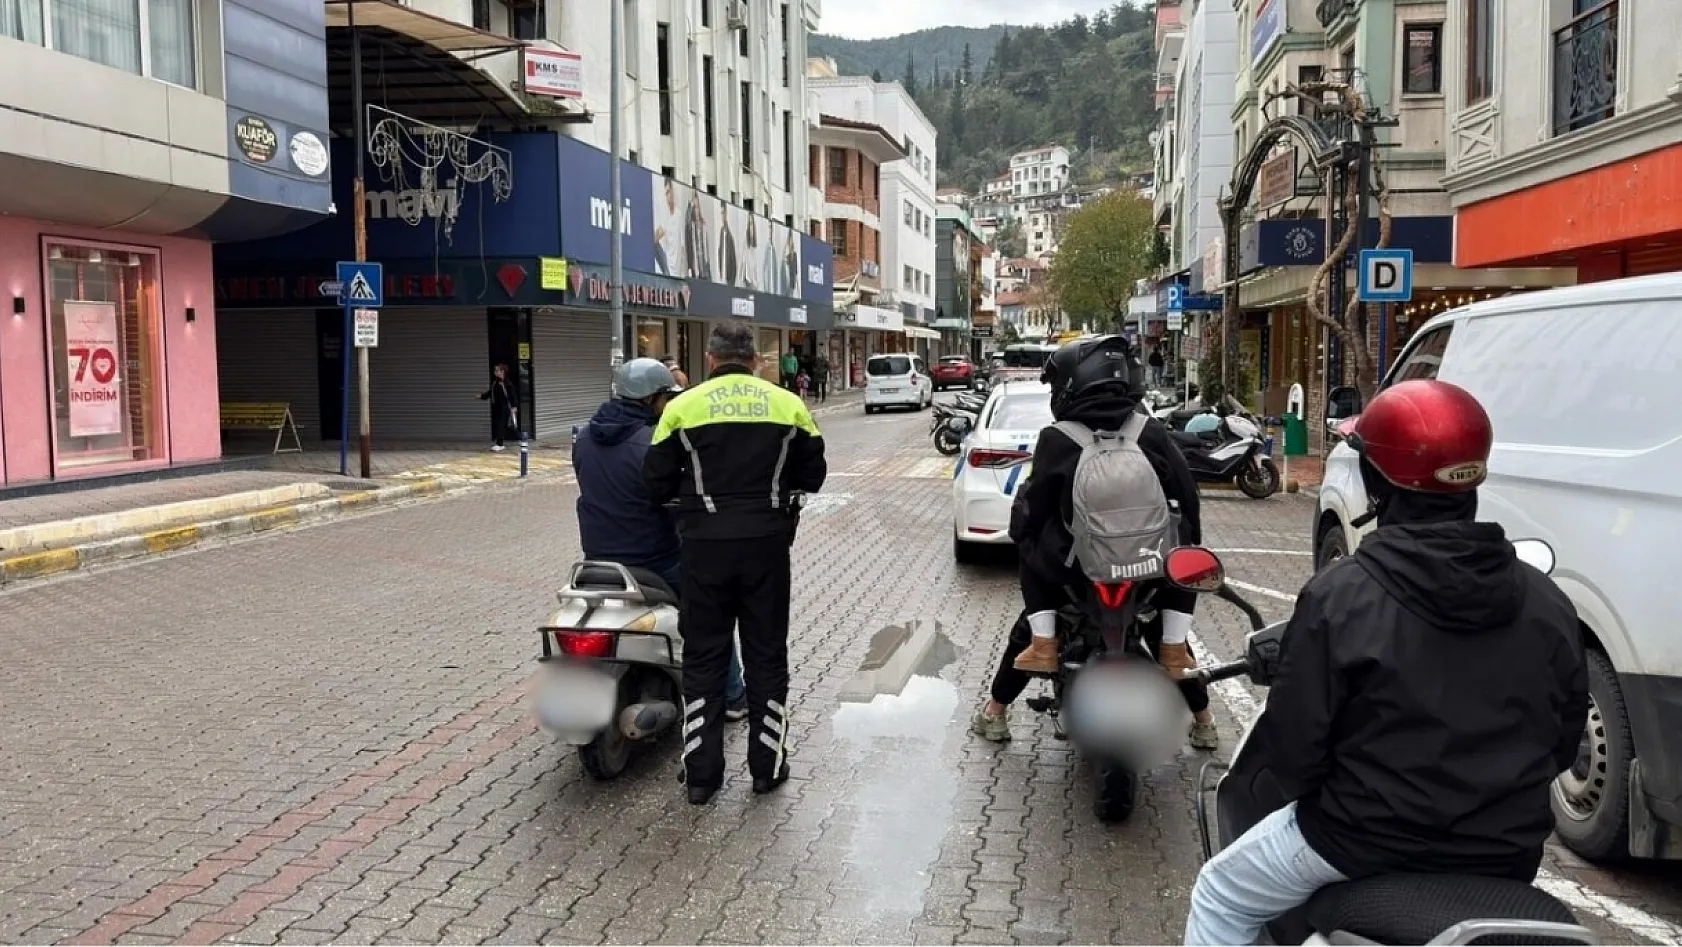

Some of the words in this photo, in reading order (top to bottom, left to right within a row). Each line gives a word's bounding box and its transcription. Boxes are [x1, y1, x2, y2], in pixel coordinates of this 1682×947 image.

[535, 61, 558, 73] KMS
[365, 178, 458, 218] mavi
[1374, 261, 1396, 288] D
[1167, 287, 1179, 309] P
[68, 347, 116, 384] 70
[70, 387, 117, 402] İNDİRİM
[1111, 557, 1158, 579] PUMA
